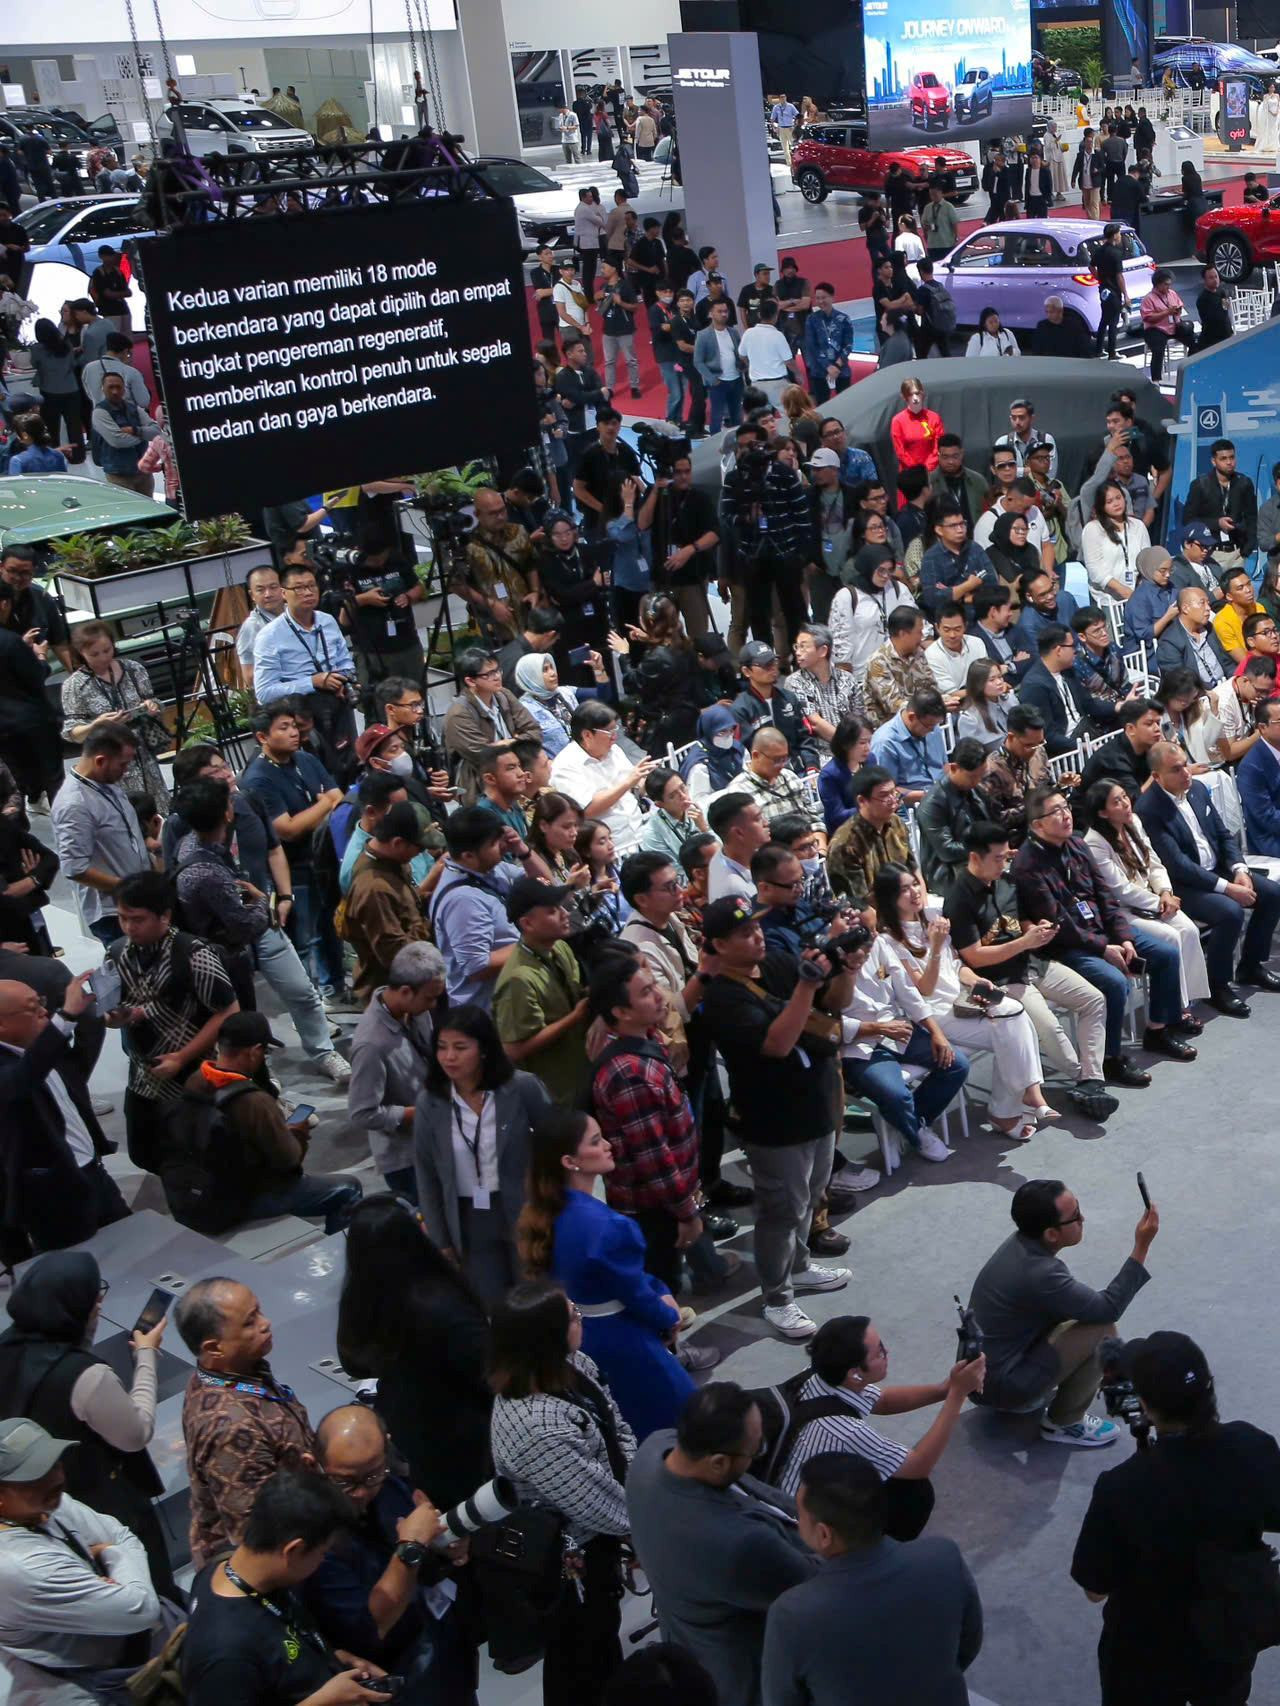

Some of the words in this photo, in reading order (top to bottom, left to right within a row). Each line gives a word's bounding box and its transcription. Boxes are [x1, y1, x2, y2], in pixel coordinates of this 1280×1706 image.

[901, 20, 955, 40] JOURNEY
[673, 68, 730, 79] JETOUR
[167, 287, 230, 312] Kedua
[233, 279, 290, 302] varian
[293, 267, 363, 295] memiliki
[367, 264, 387, 283] 18
[391, 258, 437, 281] mode
[173, 316, 278, 345] berkendara
[282, 309, 325, 335] yang
[329, 298, 377, 323] dapat
[380, 291, 427, 316] dipilih
[430, 287, 460, 307] dan
[463, 278, 512, 302] empat
[179, 352, 243, 379] tingkat
[246, 338, 355, 373] pengereman
[358, 318, 449, 350] regeneratif,
[185, 379, 297, 411] memberikan
[300, 364, 358, 391] kontrol
[361, 356, 412, 385] penuh
[415, 348, 460, 371] untuk
[462, 339, 512, 364] segala
[191, 419, 255, 444] medan
[258, 412, 292, 431] dan
[296, 404, 338, 428] gaya
[341, 386, 437, 416] berkendara.
